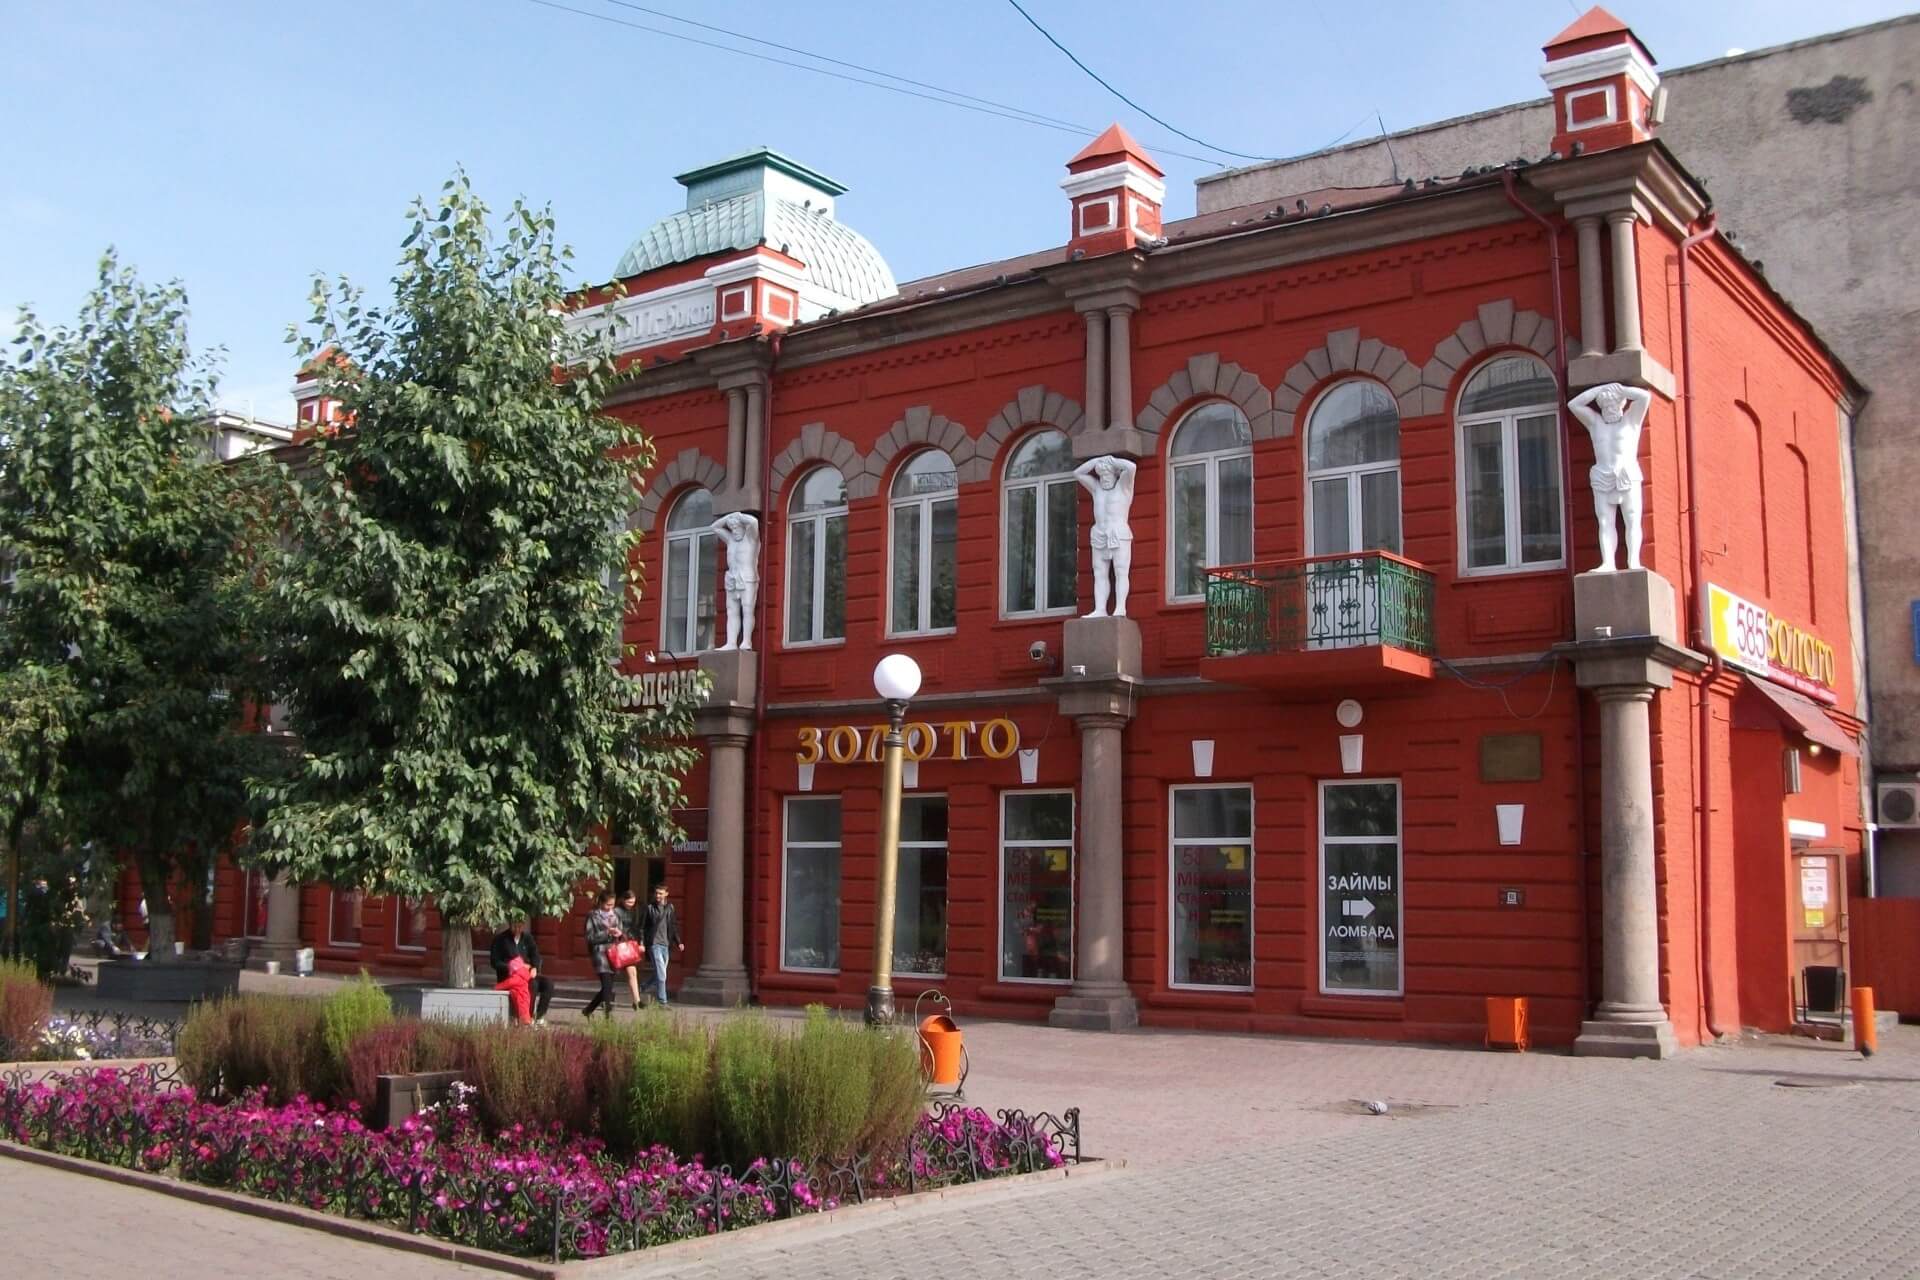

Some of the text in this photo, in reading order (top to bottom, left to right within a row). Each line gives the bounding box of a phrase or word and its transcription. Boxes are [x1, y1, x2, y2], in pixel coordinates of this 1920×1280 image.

[1736, 602, 1835, 687] 585 ЗОЛОТО
[797, 718, 1020, 764] ЗОЛОТО
[1328, 872, 1391, 890] ЗАЙМЫ
[1328, 925, 1395, 940] ЛОМБАРД
